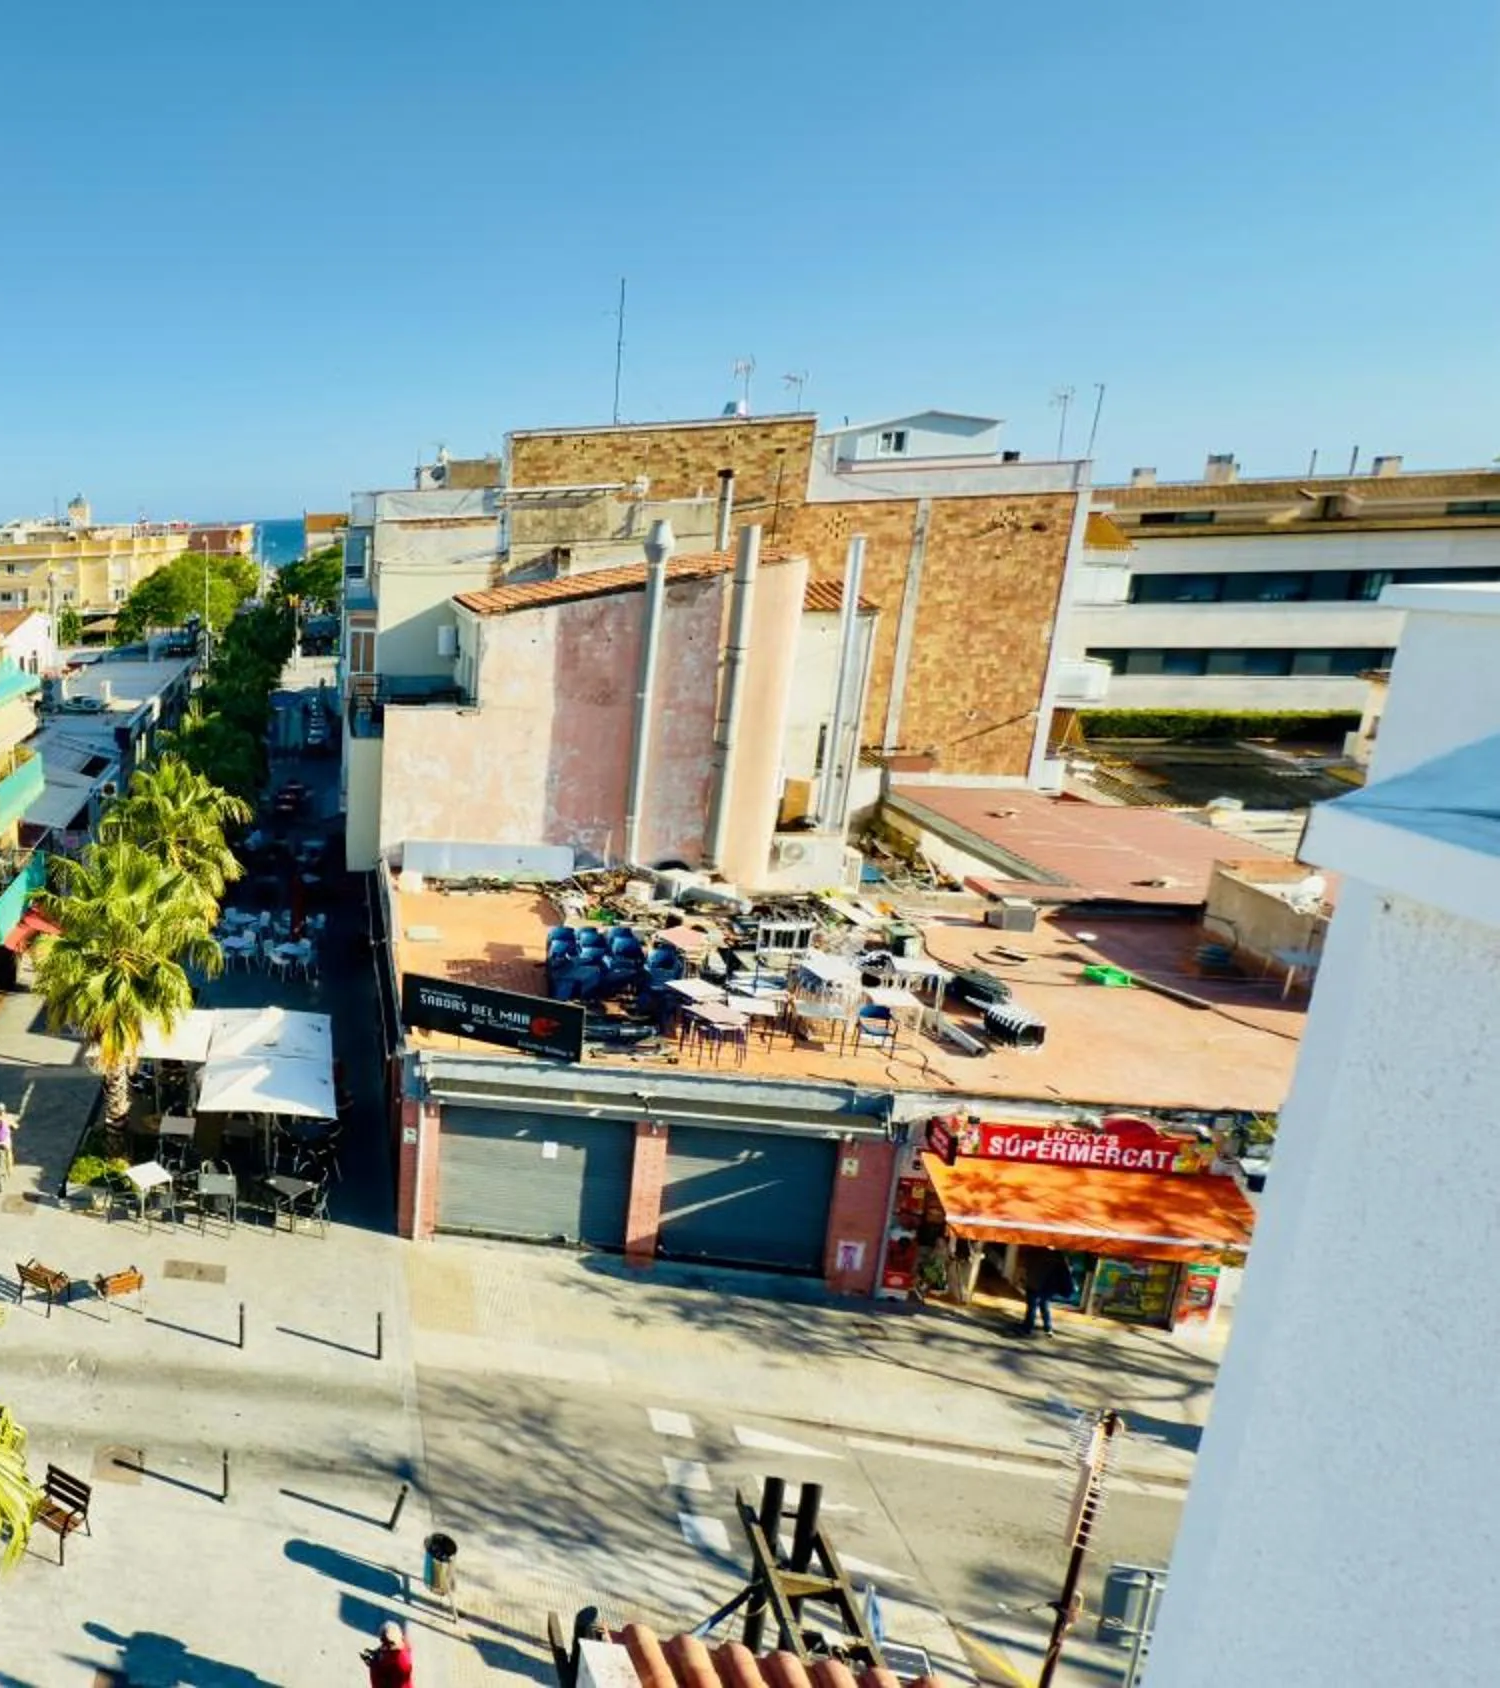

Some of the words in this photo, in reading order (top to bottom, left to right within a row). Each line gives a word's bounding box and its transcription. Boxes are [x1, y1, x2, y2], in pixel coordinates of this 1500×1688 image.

[419, 993, 468, 1014] SABORS
[470, 1003, 495, 1018] DEL
[1043, 1129, 1119, 1147] LUCKY'S
